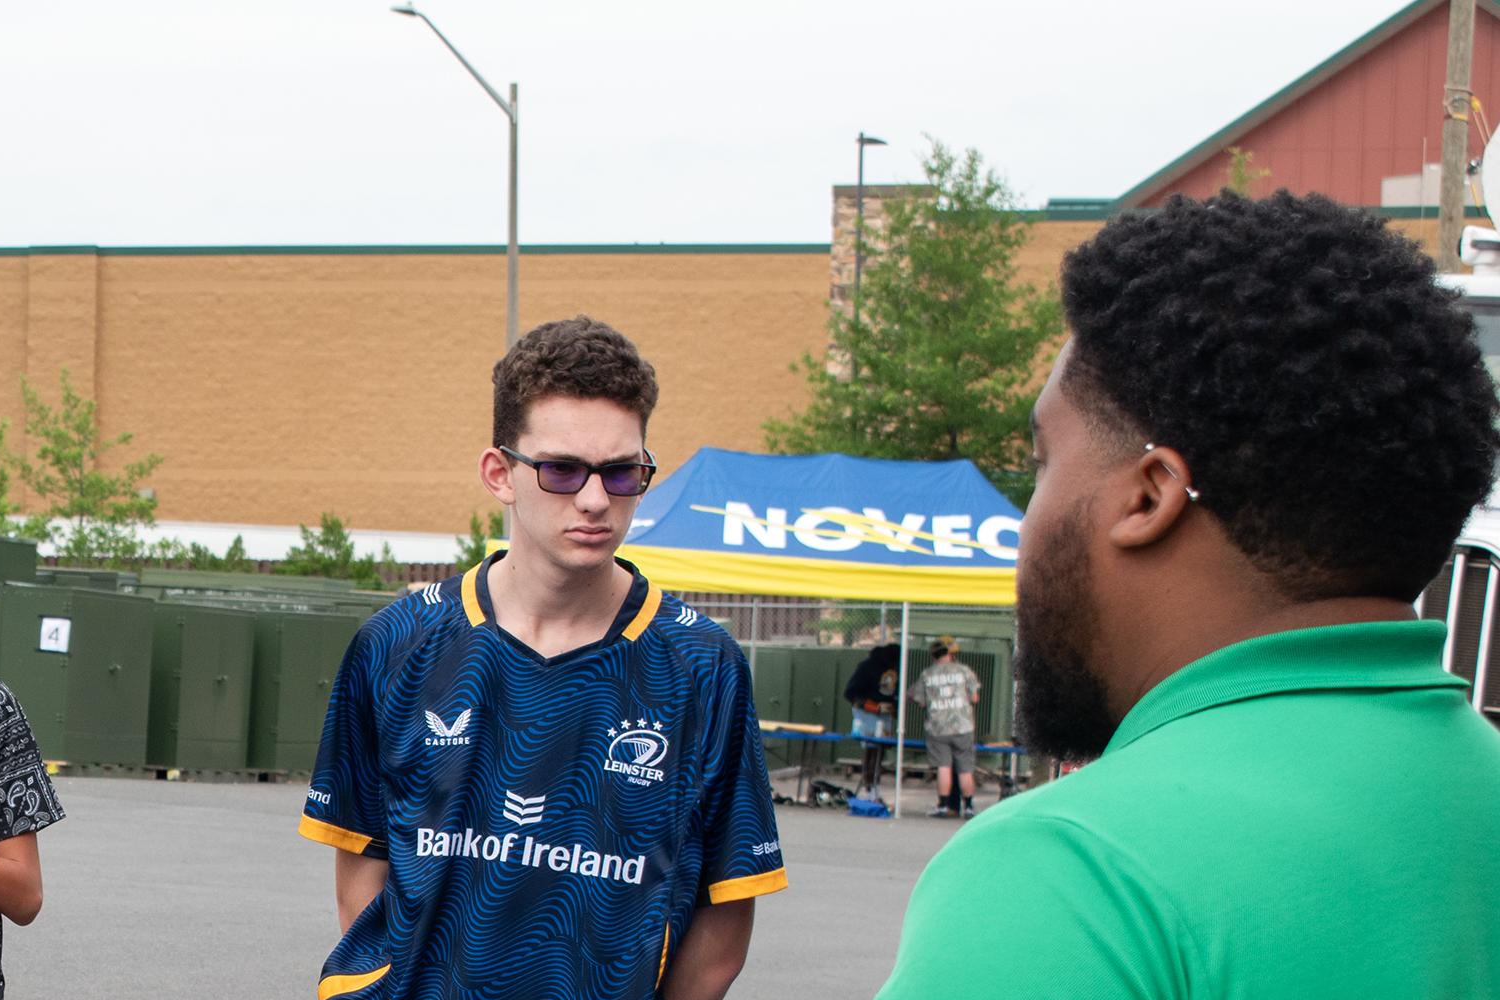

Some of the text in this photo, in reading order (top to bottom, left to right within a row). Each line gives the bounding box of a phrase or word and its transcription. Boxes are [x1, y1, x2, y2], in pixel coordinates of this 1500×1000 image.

[723, 501, 1020, 560] NOVEC
[47, 626, 60, 645] 4
[925, 674, 965, 687] JESUS
[940, 686, 954, 698] IS
[930, 697, 964, 710] ALIVE
[425, 737, 470, 746] CASTORE
[604, 759, 664, 781] LEINSTER
[627, 776, 652, 787] RUGBY
[416, 828, 646, 885] Bank of Ireland
